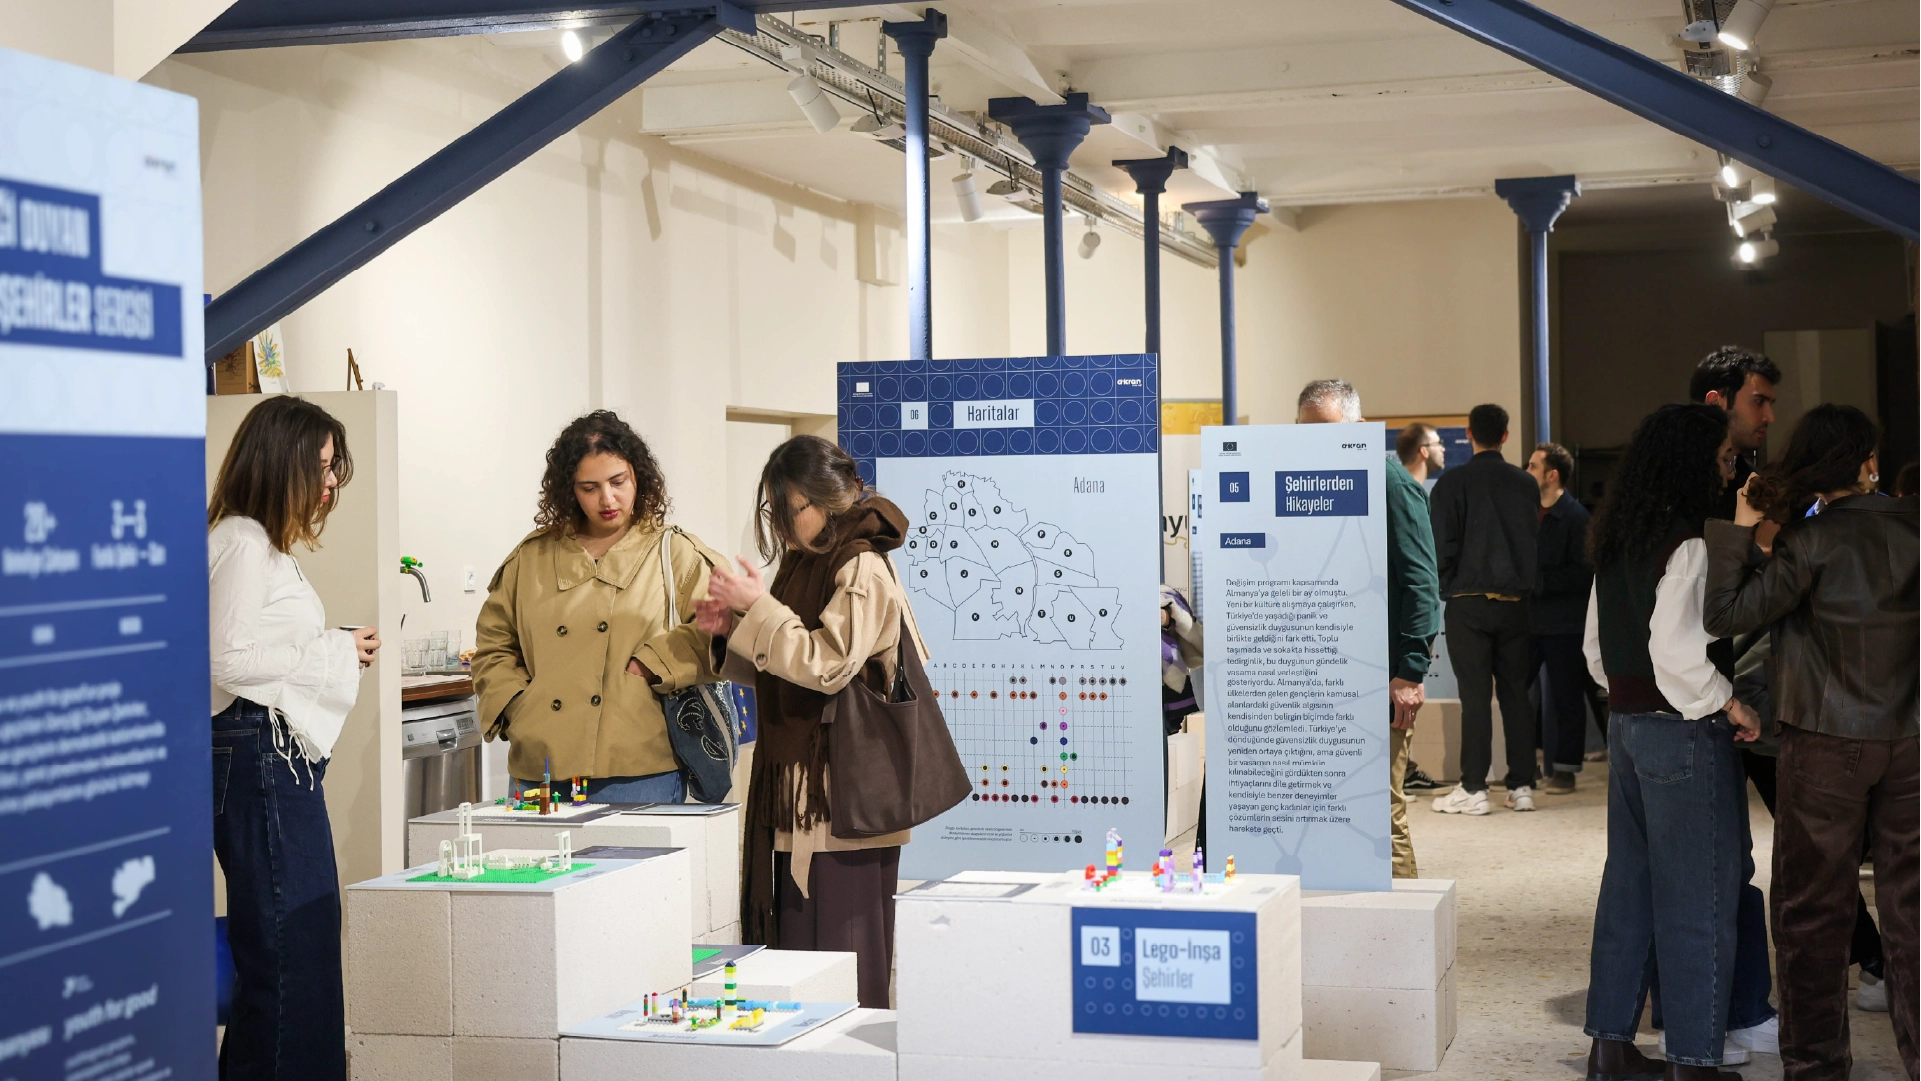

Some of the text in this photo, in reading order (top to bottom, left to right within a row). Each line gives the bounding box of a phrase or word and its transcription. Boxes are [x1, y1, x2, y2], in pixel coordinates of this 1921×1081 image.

[20, 198, 90, 259] DUYAN
[0, 271, 154, 340] ŞEHİRLER SERGİSİ
[910, 409, 919, 420] 06
[967, 405, 1020, 421] Haritalar
[1073, 477, 1105, 494] Adana
[1229, 482, 1240, 493] 05
[1285, 476, 1354, 493] Şehirlerden
[1286, 496, 1334, 514] Hikayeler
[1225, 537, 1252, 546] Adana
[1226, 579, 1255, 587] Değişim
[1226, 590, 1268, 598] Almanya'ya
[1271, 590, 1290, 598] geleli
[1282, 601, 1316, 609] alışmaya
[1318, 601, 1356, 609] çalışırken,
[1226, 612, 1263, 621] Türkiye'de
[1265, 612, 1295, 621] yaşadığı
[1297, 613, 1317, 621] panik
[1227, 623, 1353, 632] güvensizlik duygusunun kendisiyle
[1253, 635, 1284, 643] geldiğini
[1318, 635, 1339, 643] Toplu
[1227, 646, 1261, 655] taşımada
[1305, 646, 1338, 655] hissettiği
[1227, 658, 1265, 666] tedirginlik,
[1278, 658, 1314, 666] duygunun
[1316, 658, 1348, 666] gündelik
[1227, 678, 1275, 687] gösteriyordu.
[1277, 679, 1323, 687] Almanya'da,
[1268, 691, 1288, 699] gelen
[1290, 690, 1325, 699] gençlerin
[1227, 701, 1333, 710] alanlardaki güvenlik algısının
[1227, 712, 1272, 720] kendisinden
[1274, 713, 1301, 721] belirgin
[1303, 713, 1333, 722] biçimde
[1228, 724, 1346, 734] olduğunu gözlemledi. Türkiye'ye
[1228, 736, 1365, 746] döndüğünde güvensizlik duygusunun
[1228, 748, 1257, 756] yeniden
[1259, 748, 1282, 756] ortaya
[1285, 748, 1314, 757] çıktığını,
[1335, 749, 1362, 757] güvenli
[1229, 768, 1283, 777] kılınabileceğini
[1285, 769, 1322, 778] gördükten
[1229, 780, 1271, 789] ihtiyaçlarını
[1273, 780, 1286, 788] dile
[1288, 780, 1322, 789] getirmek
[1229, 791, 1266, 800] kendisiyle
[1295, 792, 1337, 801] deneyimler
[1229, 804, 1259, 812] yaşayan
[1261, 804, 1279, 812] genç
[1281, 803, 1311, 811] kadınlar
[1313, 804, 1325, 812] için
[1229, 814, 1270, 822] çözümlerin
[1229, 825, 1283, 834] harekete geçti.
[1091, 936, 1222, 963] 03 Lego-İnşa
[1142, 966, 1195, 990] Şehirler
